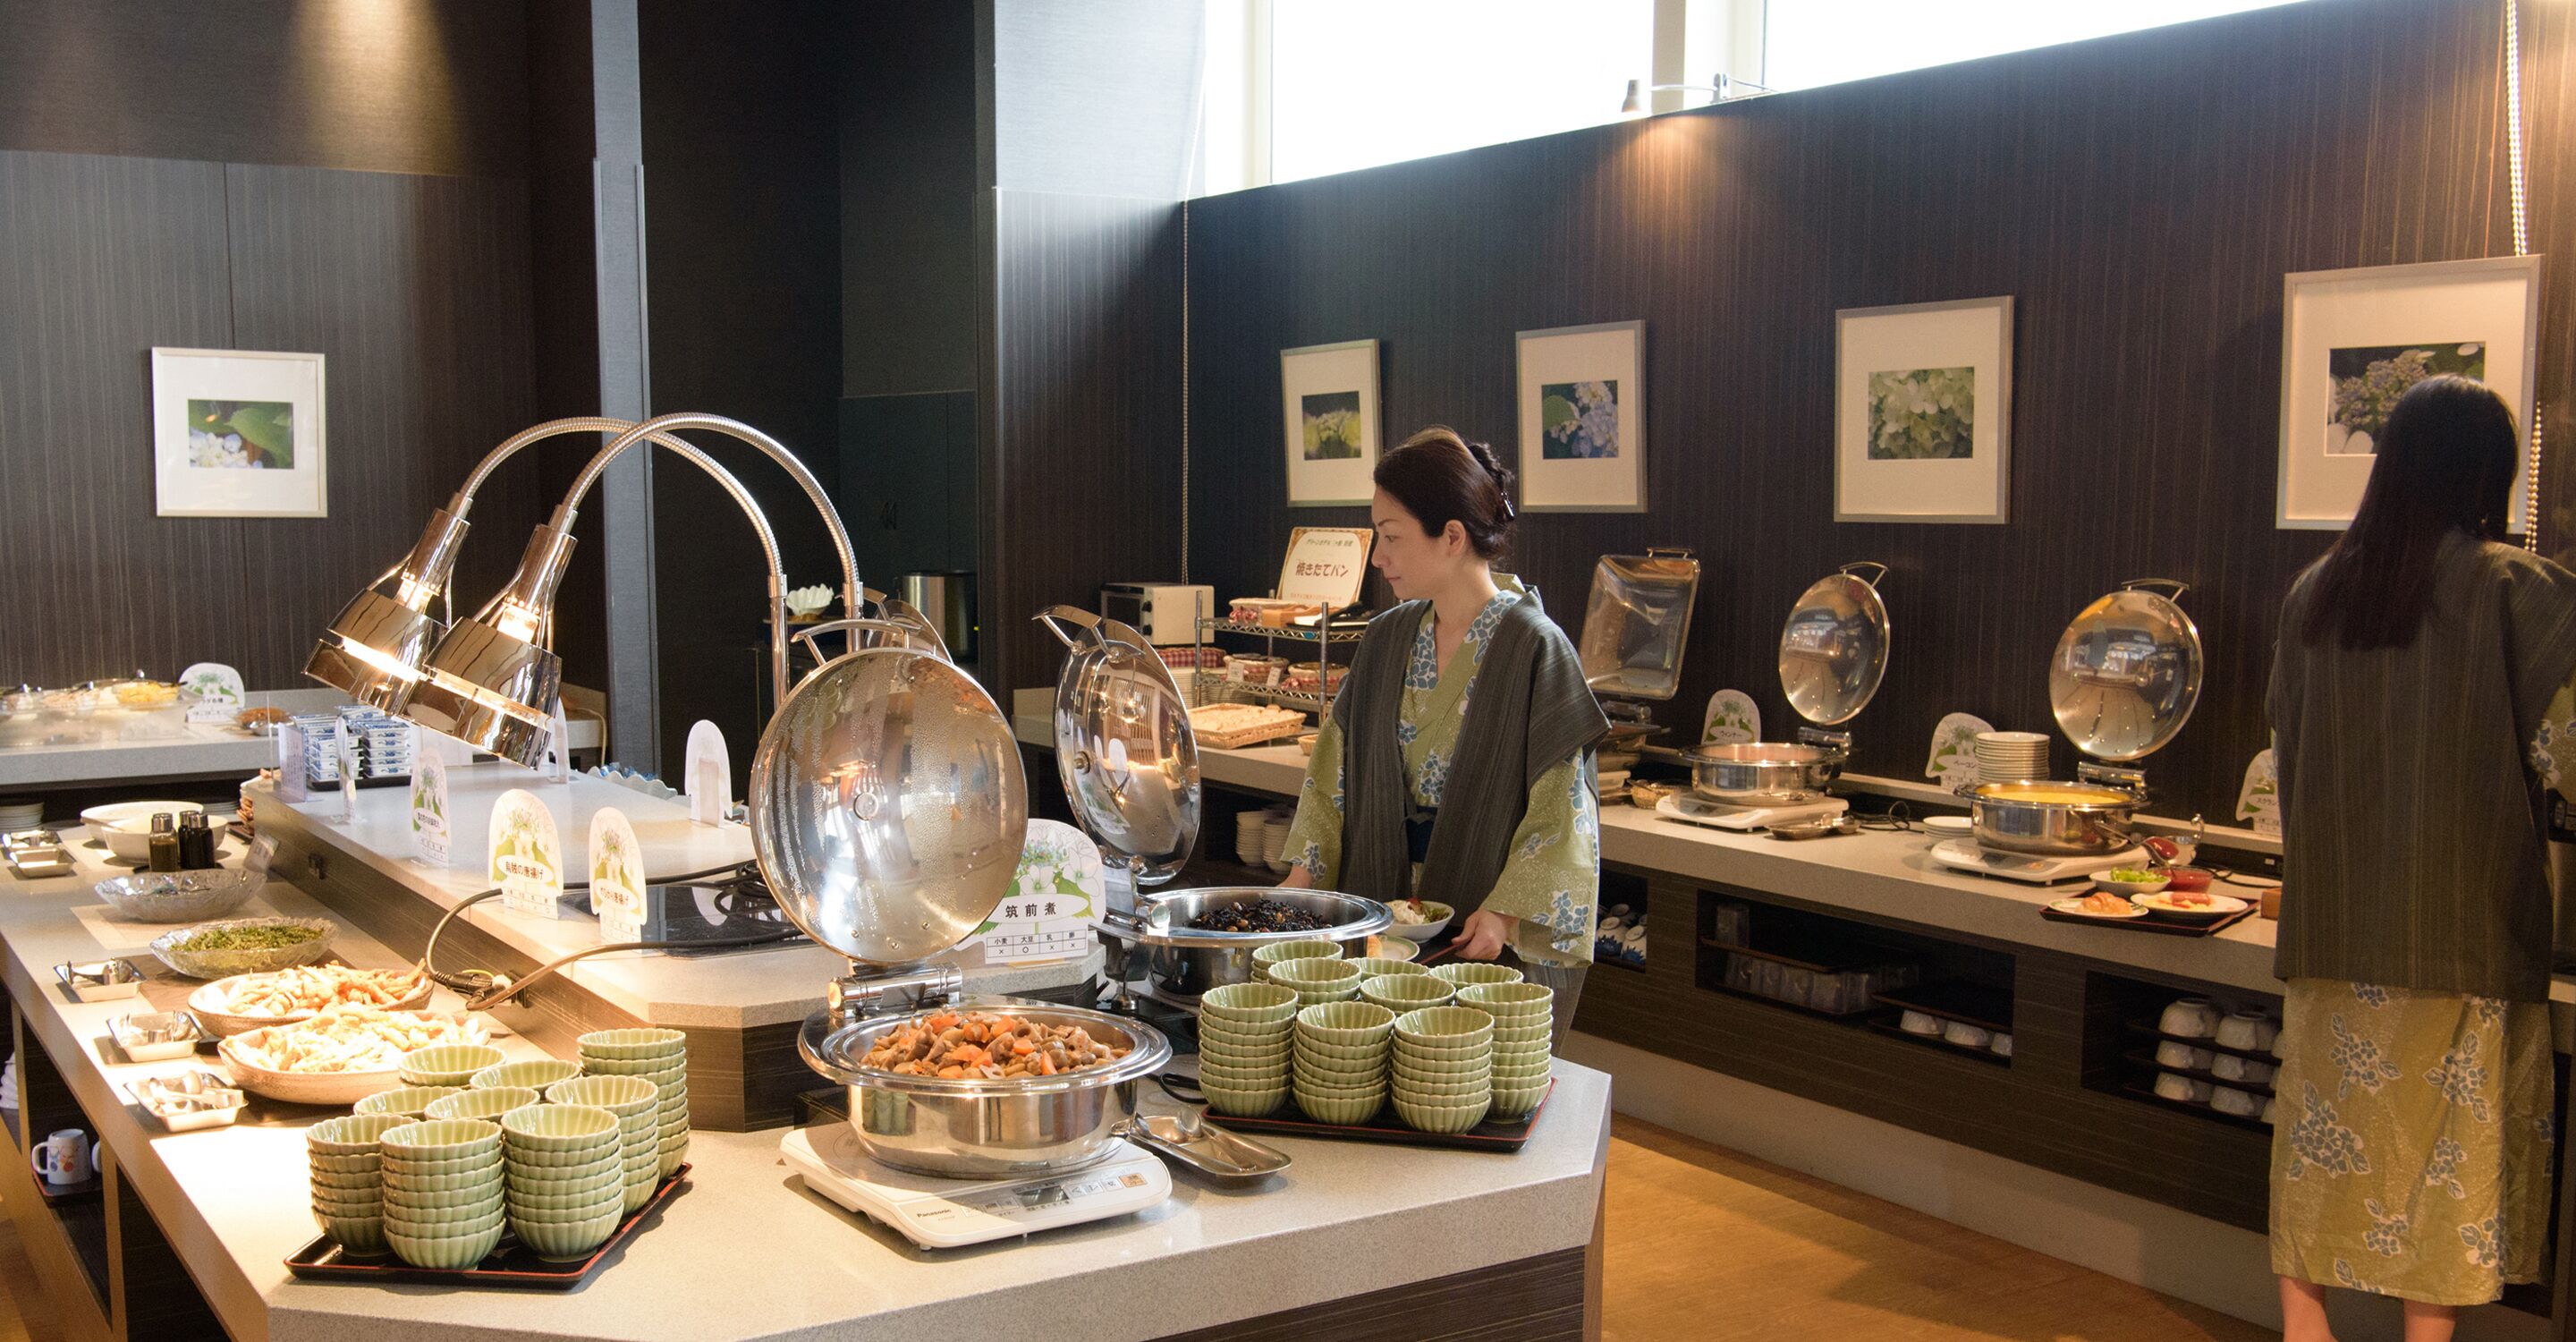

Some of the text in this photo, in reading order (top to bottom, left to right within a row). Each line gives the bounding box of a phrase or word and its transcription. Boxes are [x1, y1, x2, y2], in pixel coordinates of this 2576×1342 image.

[1295, 562, 1349, 577] 焼きたてパン
[1005, 902, 1056, 919] 筑前煮
[917, 1209, 952, 1218] Panasonic
